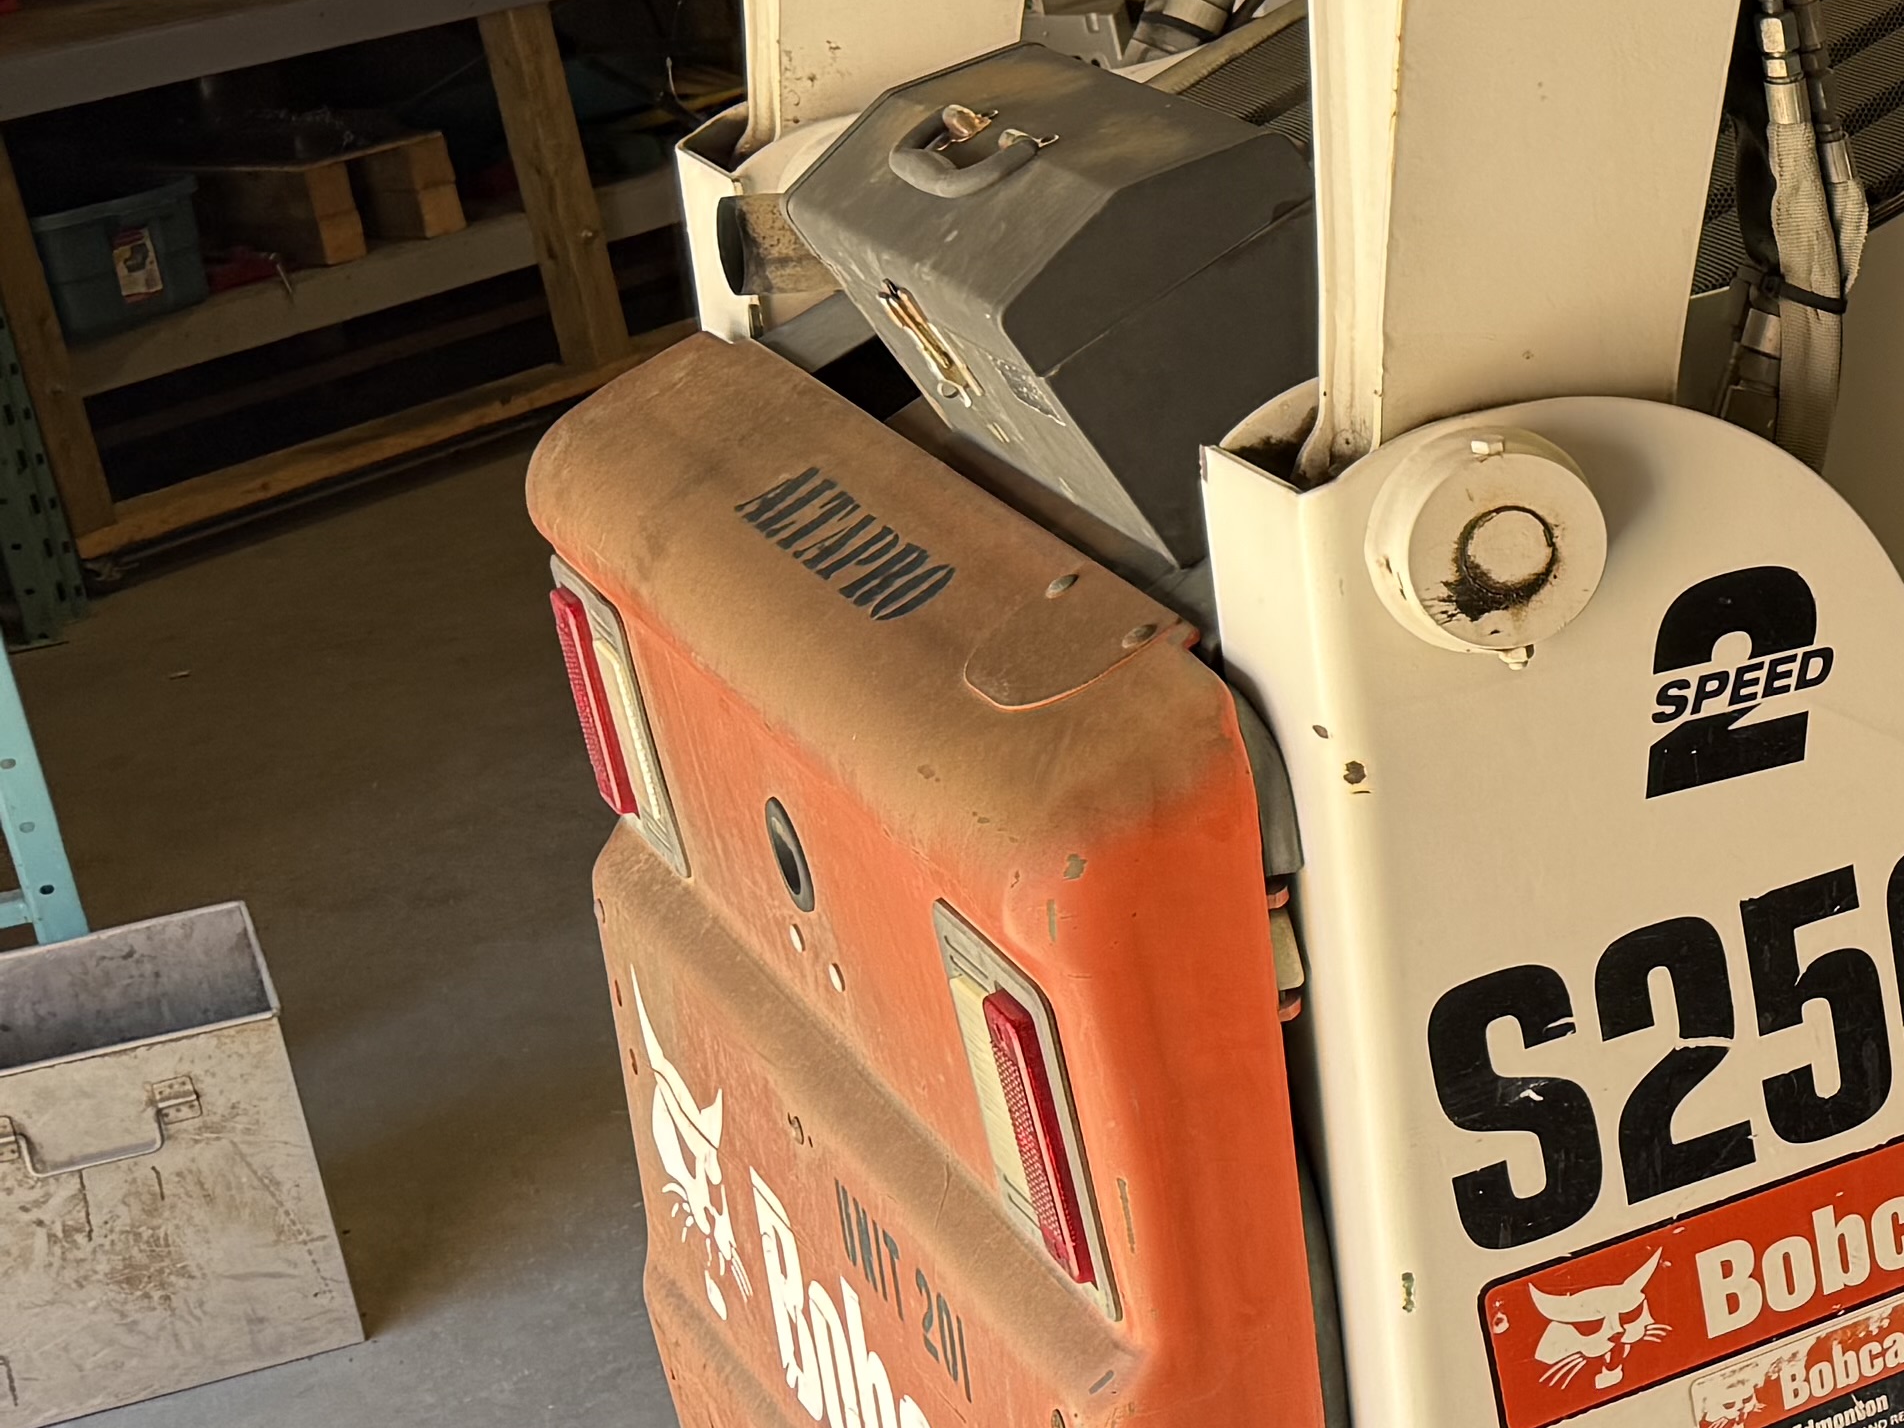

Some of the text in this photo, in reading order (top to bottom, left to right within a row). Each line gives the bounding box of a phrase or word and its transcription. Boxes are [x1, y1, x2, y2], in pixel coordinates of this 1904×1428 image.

[734, 466, 955, 621] ALTAPRO
[1645, 565, 1818, 800] 2
[1651, 646, 1835, 725] SPEED
[834, 1177, 973, 1403] UNIT 201
